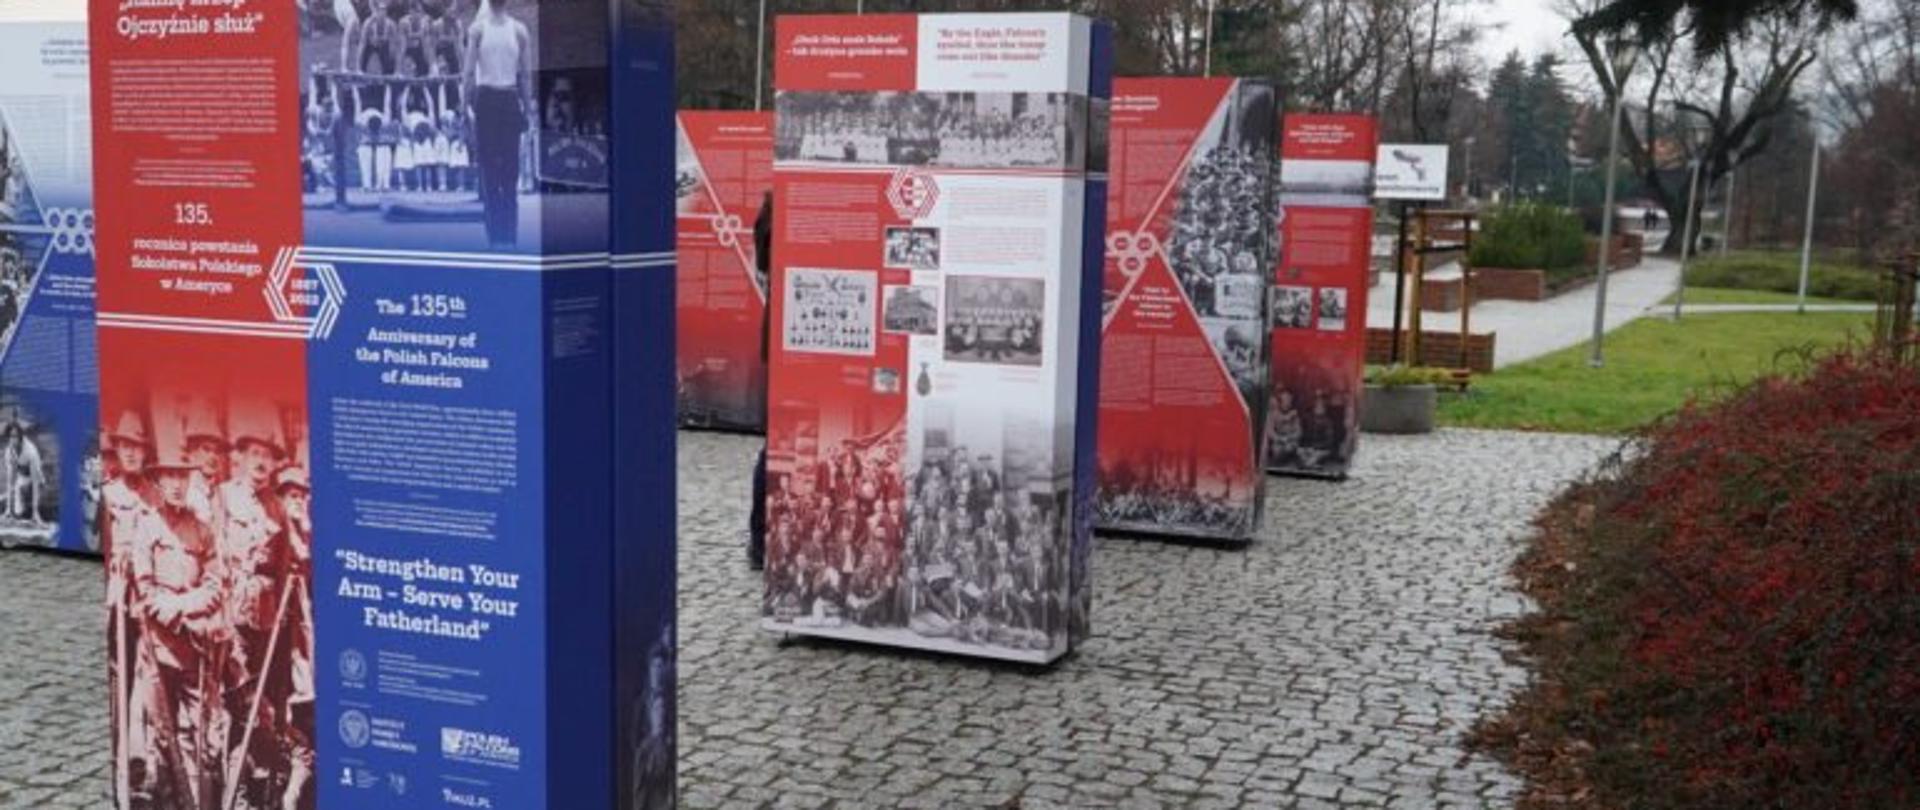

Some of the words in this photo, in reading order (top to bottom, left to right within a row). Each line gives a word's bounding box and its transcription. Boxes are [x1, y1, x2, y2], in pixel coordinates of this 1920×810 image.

[175, 203, 213, 225] 135.
[134, 238, 188, 250] rocznica
[190, 240, 259, 254] powstania
[199, 258, 262, 277] Polskiego
[160, 279, 173, 289] w
[174, 277, 234, 294] Ameryce
[376, 299, 406, 315] The
[368, 327, 456, 349] Anniversary
[458, 332, 477, 348] of
[356, 347, 380, 362] the
[383, 348, 428, 366] Polish
[431, 352, 489, 369] Falcons
[381, 369, 399, 384] of
[401, 371, 463, 388] America
[335, 549, 465, 582] “Strengthen
[469, 564, 520, 589] Your
[338, 577, 382, 601] Arm
[403, 584, 463, 610] Serve
[468, 591, 519, 616] Your
[363, 607, 490, 639] Fatherland”
